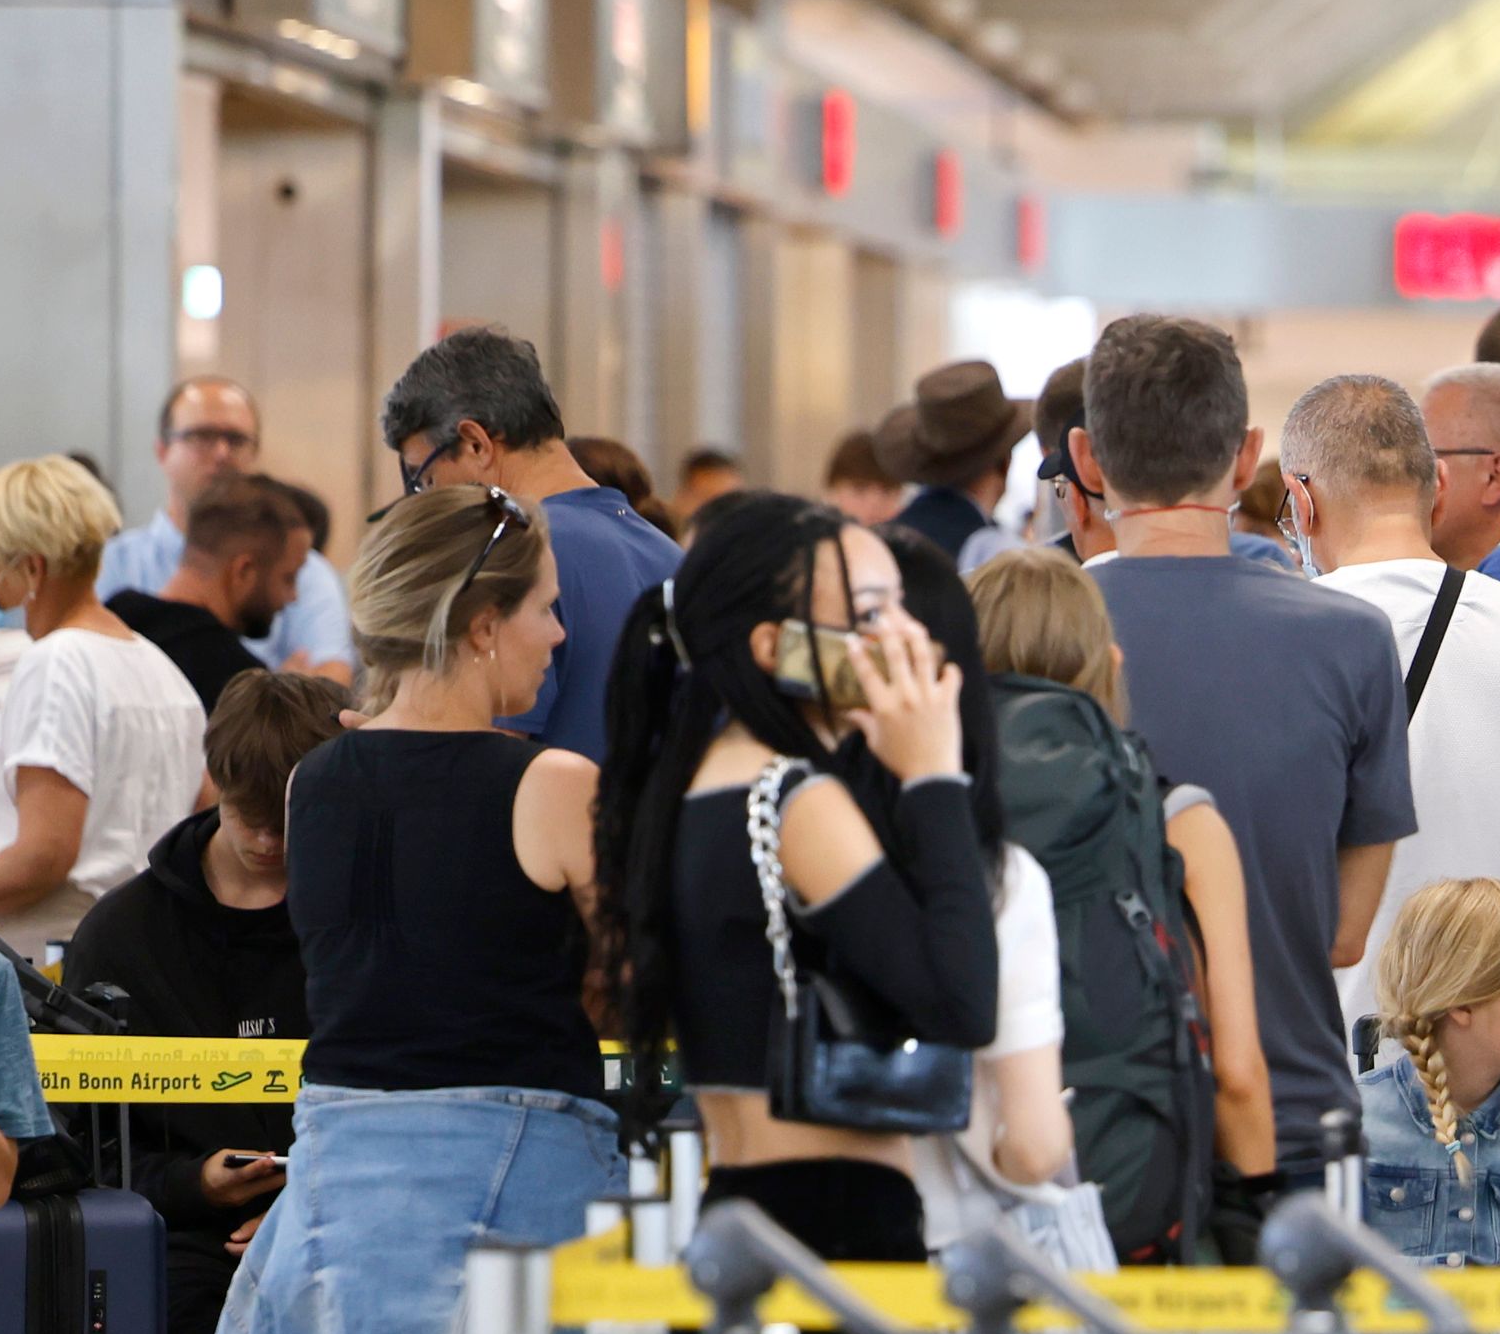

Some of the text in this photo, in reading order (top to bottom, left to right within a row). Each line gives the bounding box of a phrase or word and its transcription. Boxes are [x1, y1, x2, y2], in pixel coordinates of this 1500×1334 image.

[38, 1072, 202, 1094] öln Bonn Airport
